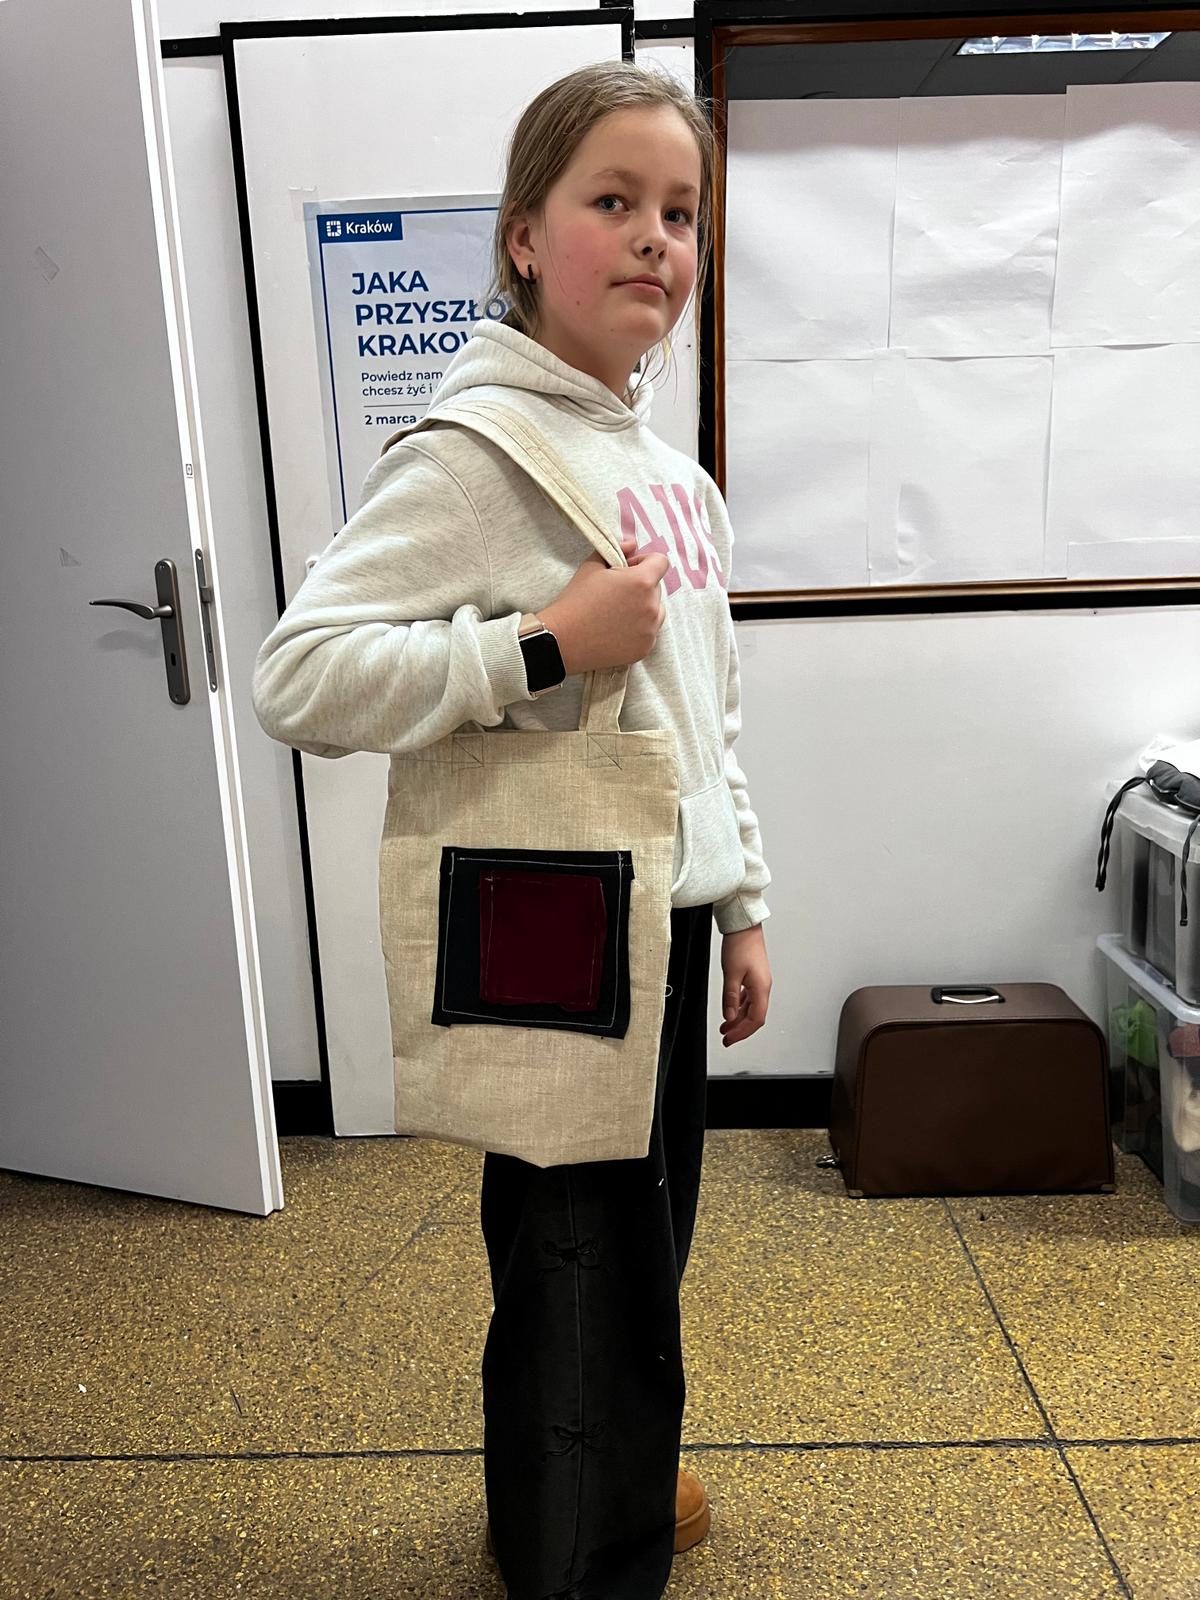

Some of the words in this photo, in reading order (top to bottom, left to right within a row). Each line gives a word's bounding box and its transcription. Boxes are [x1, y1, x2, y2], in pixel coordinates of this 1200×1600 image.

[346, 219, 393, 235] Kraków
[352, 270, 429, 295] JAKA
[361, 370, 413, 382] Powiedz
[416, 371, 443, 380] nam
[362, 385, 404, 396] chcesz
[407, 383, 426, 397] żyć
[429, 383, 433, 393] i
[364, 414, 373, 425] 2
[376, 414, 417, 425] marca
